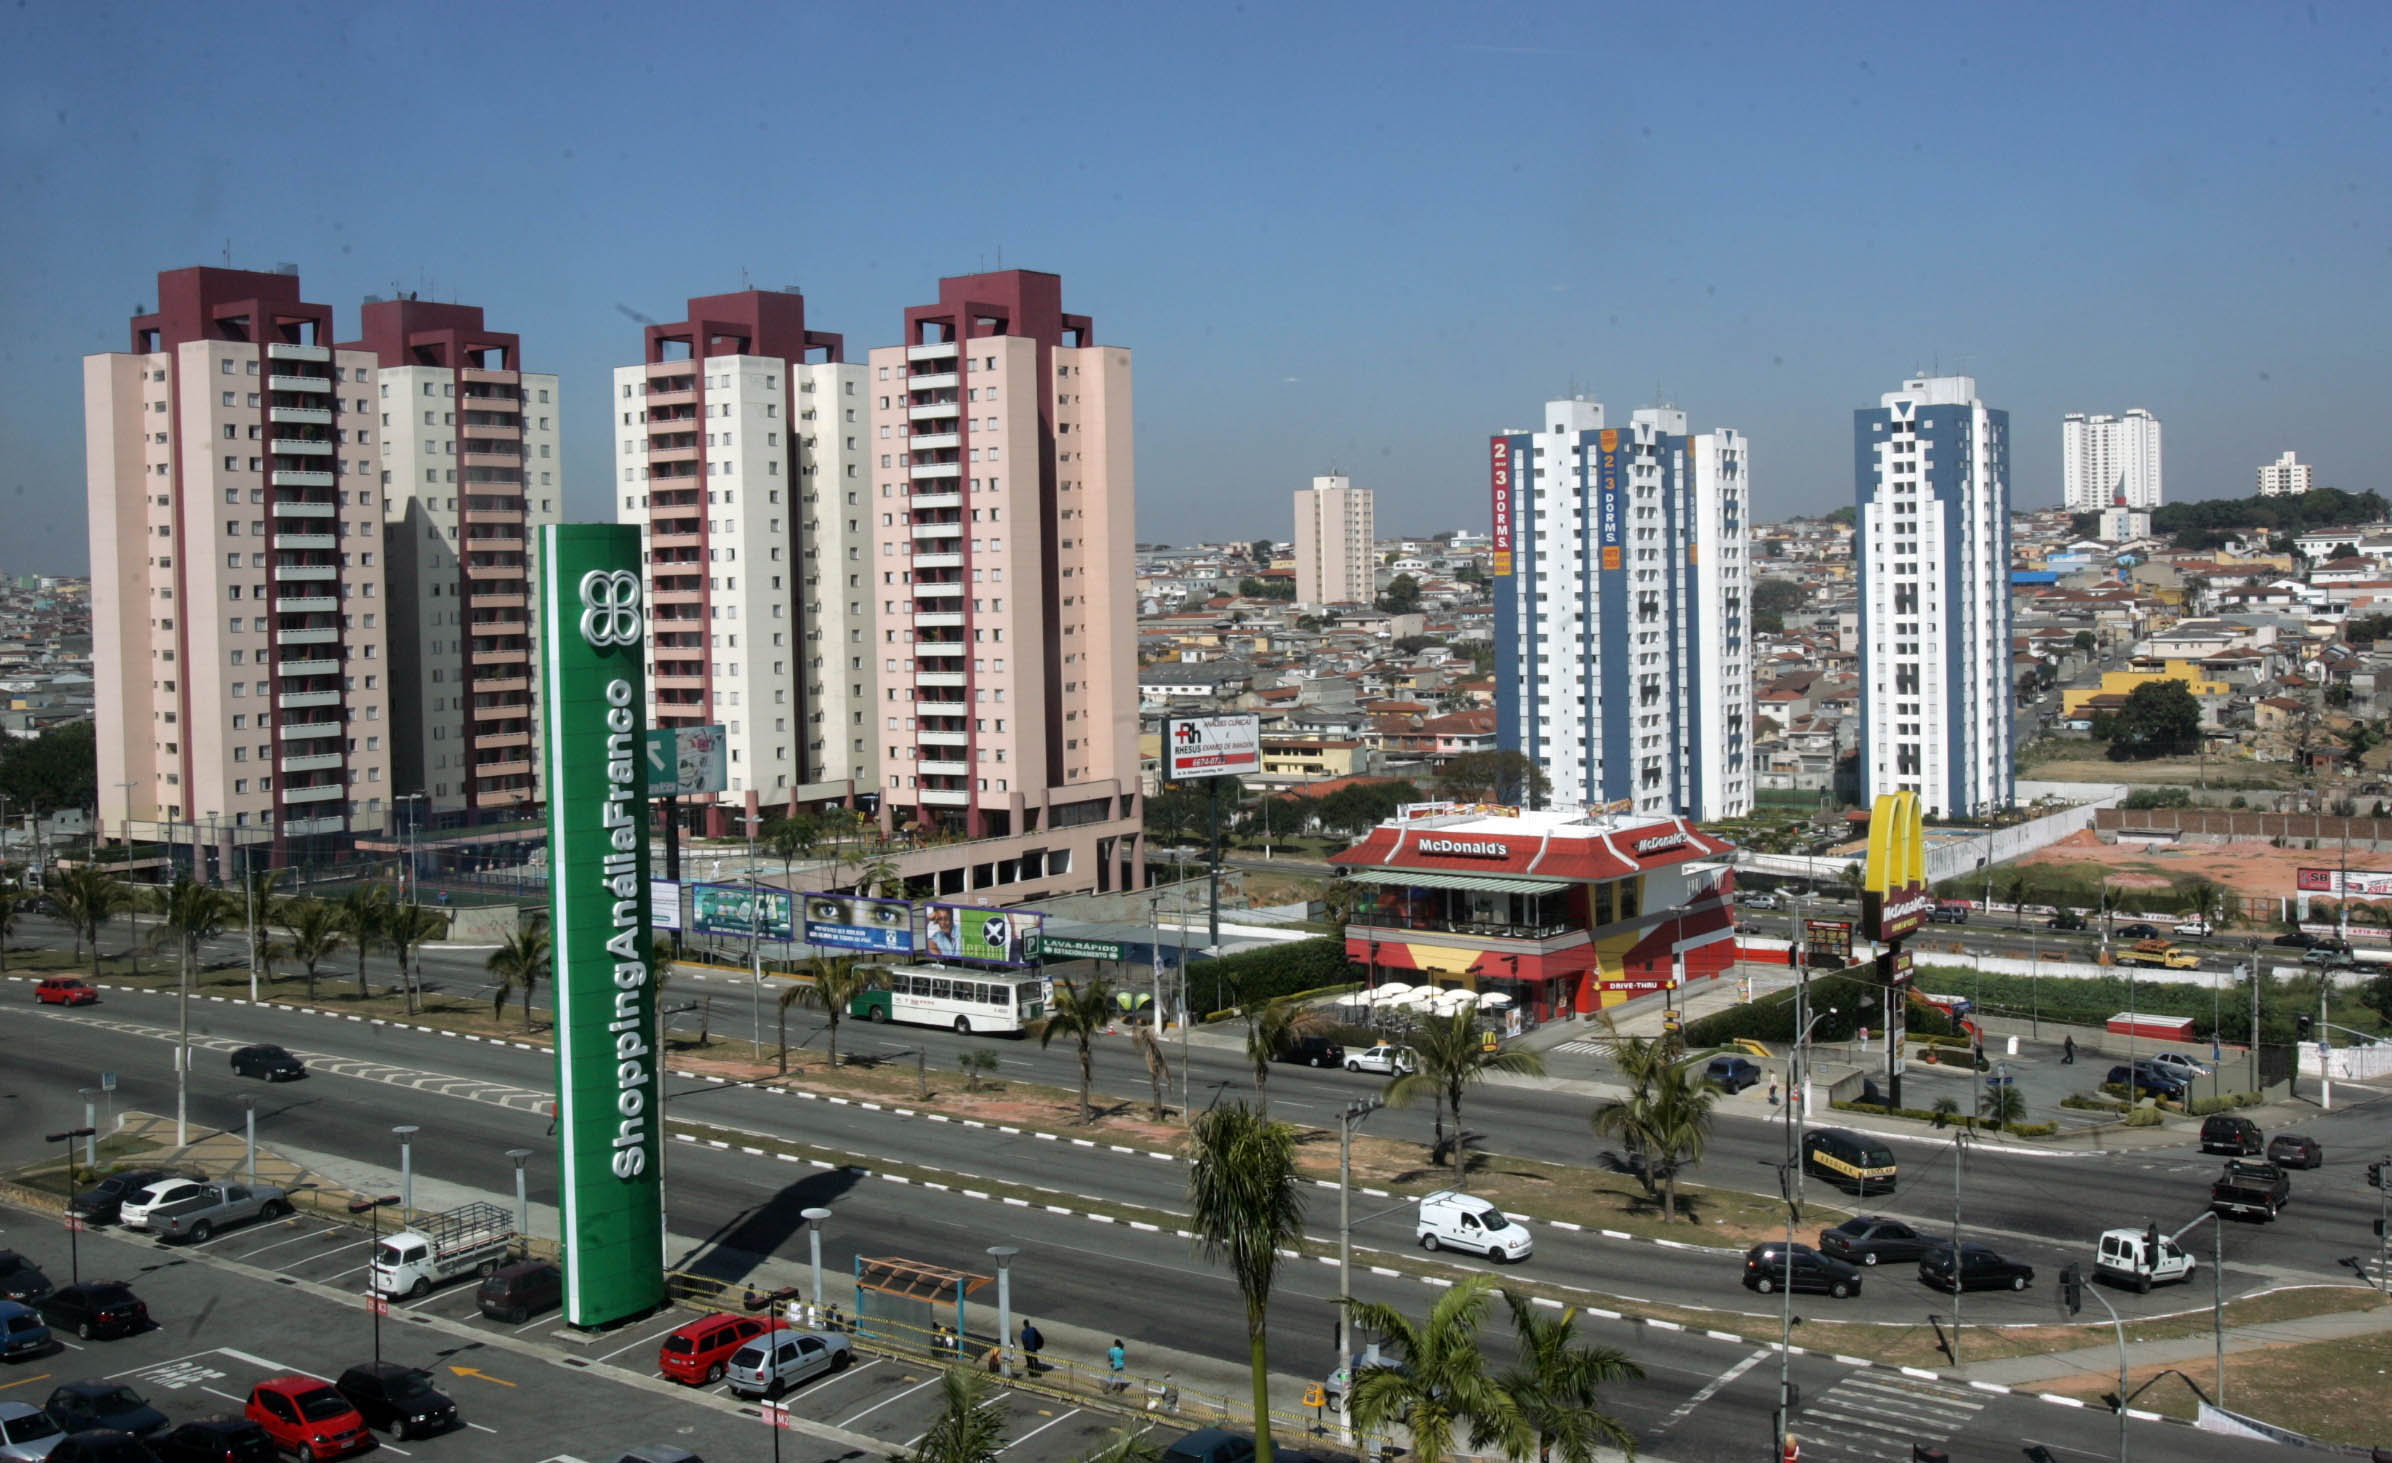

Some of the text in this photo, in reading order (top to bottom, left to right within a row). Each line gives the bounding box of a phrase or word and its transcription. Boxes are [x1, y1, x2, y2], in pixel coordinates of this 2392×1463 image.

[1494, 443, 1506, 458] 2
[1604, 455, 1615, 468] 2
[1495, 471, 1507, 485] 3
[1605, 477, 1616, 490] 3
[1175, 744, 1201, 754] RHESUS
[1419, 838, 1507, 855] McDonald's
[1043, 939, 1118, 952] LAVA-RÁPIDO
[1609, 981, 1658, 990] DRIVE-THRU
